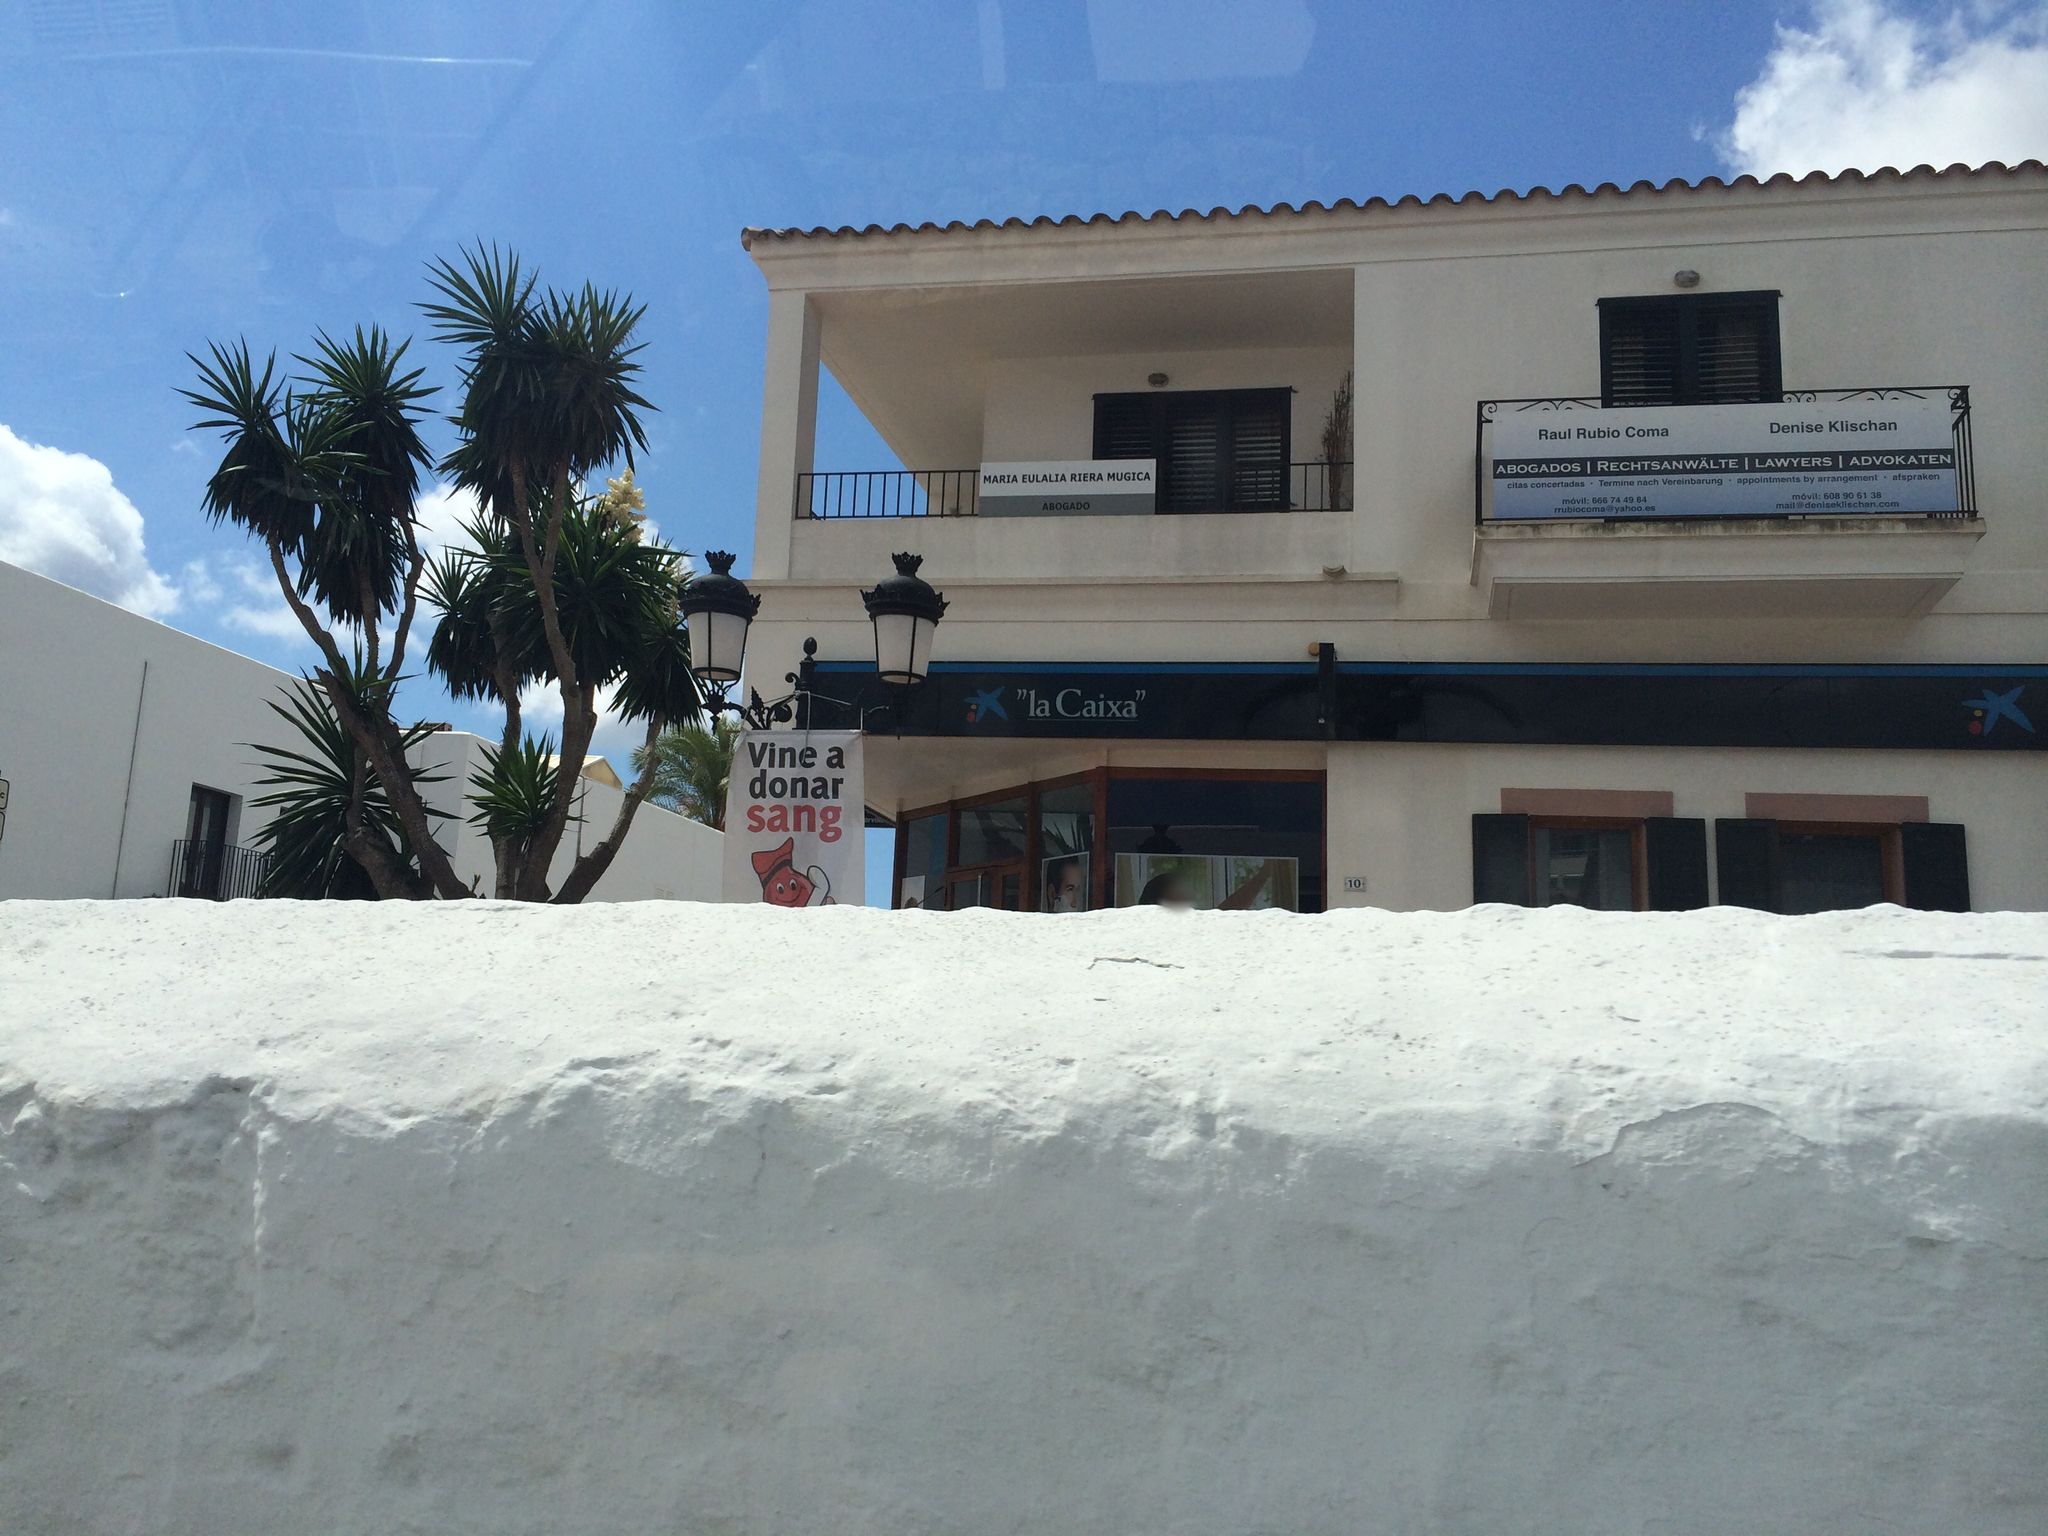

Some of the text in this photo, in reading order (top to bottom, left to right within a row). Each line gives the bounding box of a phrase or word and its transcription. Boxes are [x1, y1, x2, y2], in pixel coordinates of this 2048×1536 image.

[1538, 426, 1669, 440] Raul Rubio Coma
[1770, 420, 1898, 434] Denise Klischan
[1496, 453, 1951, 474] ABOGADOS RECHTSANWÄLTE LAWYERS ADVOKATEN
[983, 471, 1151, 484] MARIA EULALIA RIERA MUGICA
[1507, 472, 1940, 489] citas concertadas Termine nach Vereinbarung appointments by arrangement afspraken
[1562, 496, 1590, 505] móvil:
[1610, 496, 1621, 504] 74
[1623, 496, 1634, 504] 49
[1792, 491, 1821, 500] móvil:
[1842, 491, 1854, 500] 90
[1870, 491, 1882, 499] 38
[1042, 502, 1090, 511] ABOGADO
[1776, 500, 1899, 510] mail@deniseklischan.com
[748, 742, 845, 769] Vine a
[749, 769, 844, 800] donar
[747, 804, 842, 843] sang
[1348, 879, 1361, 889] 10
